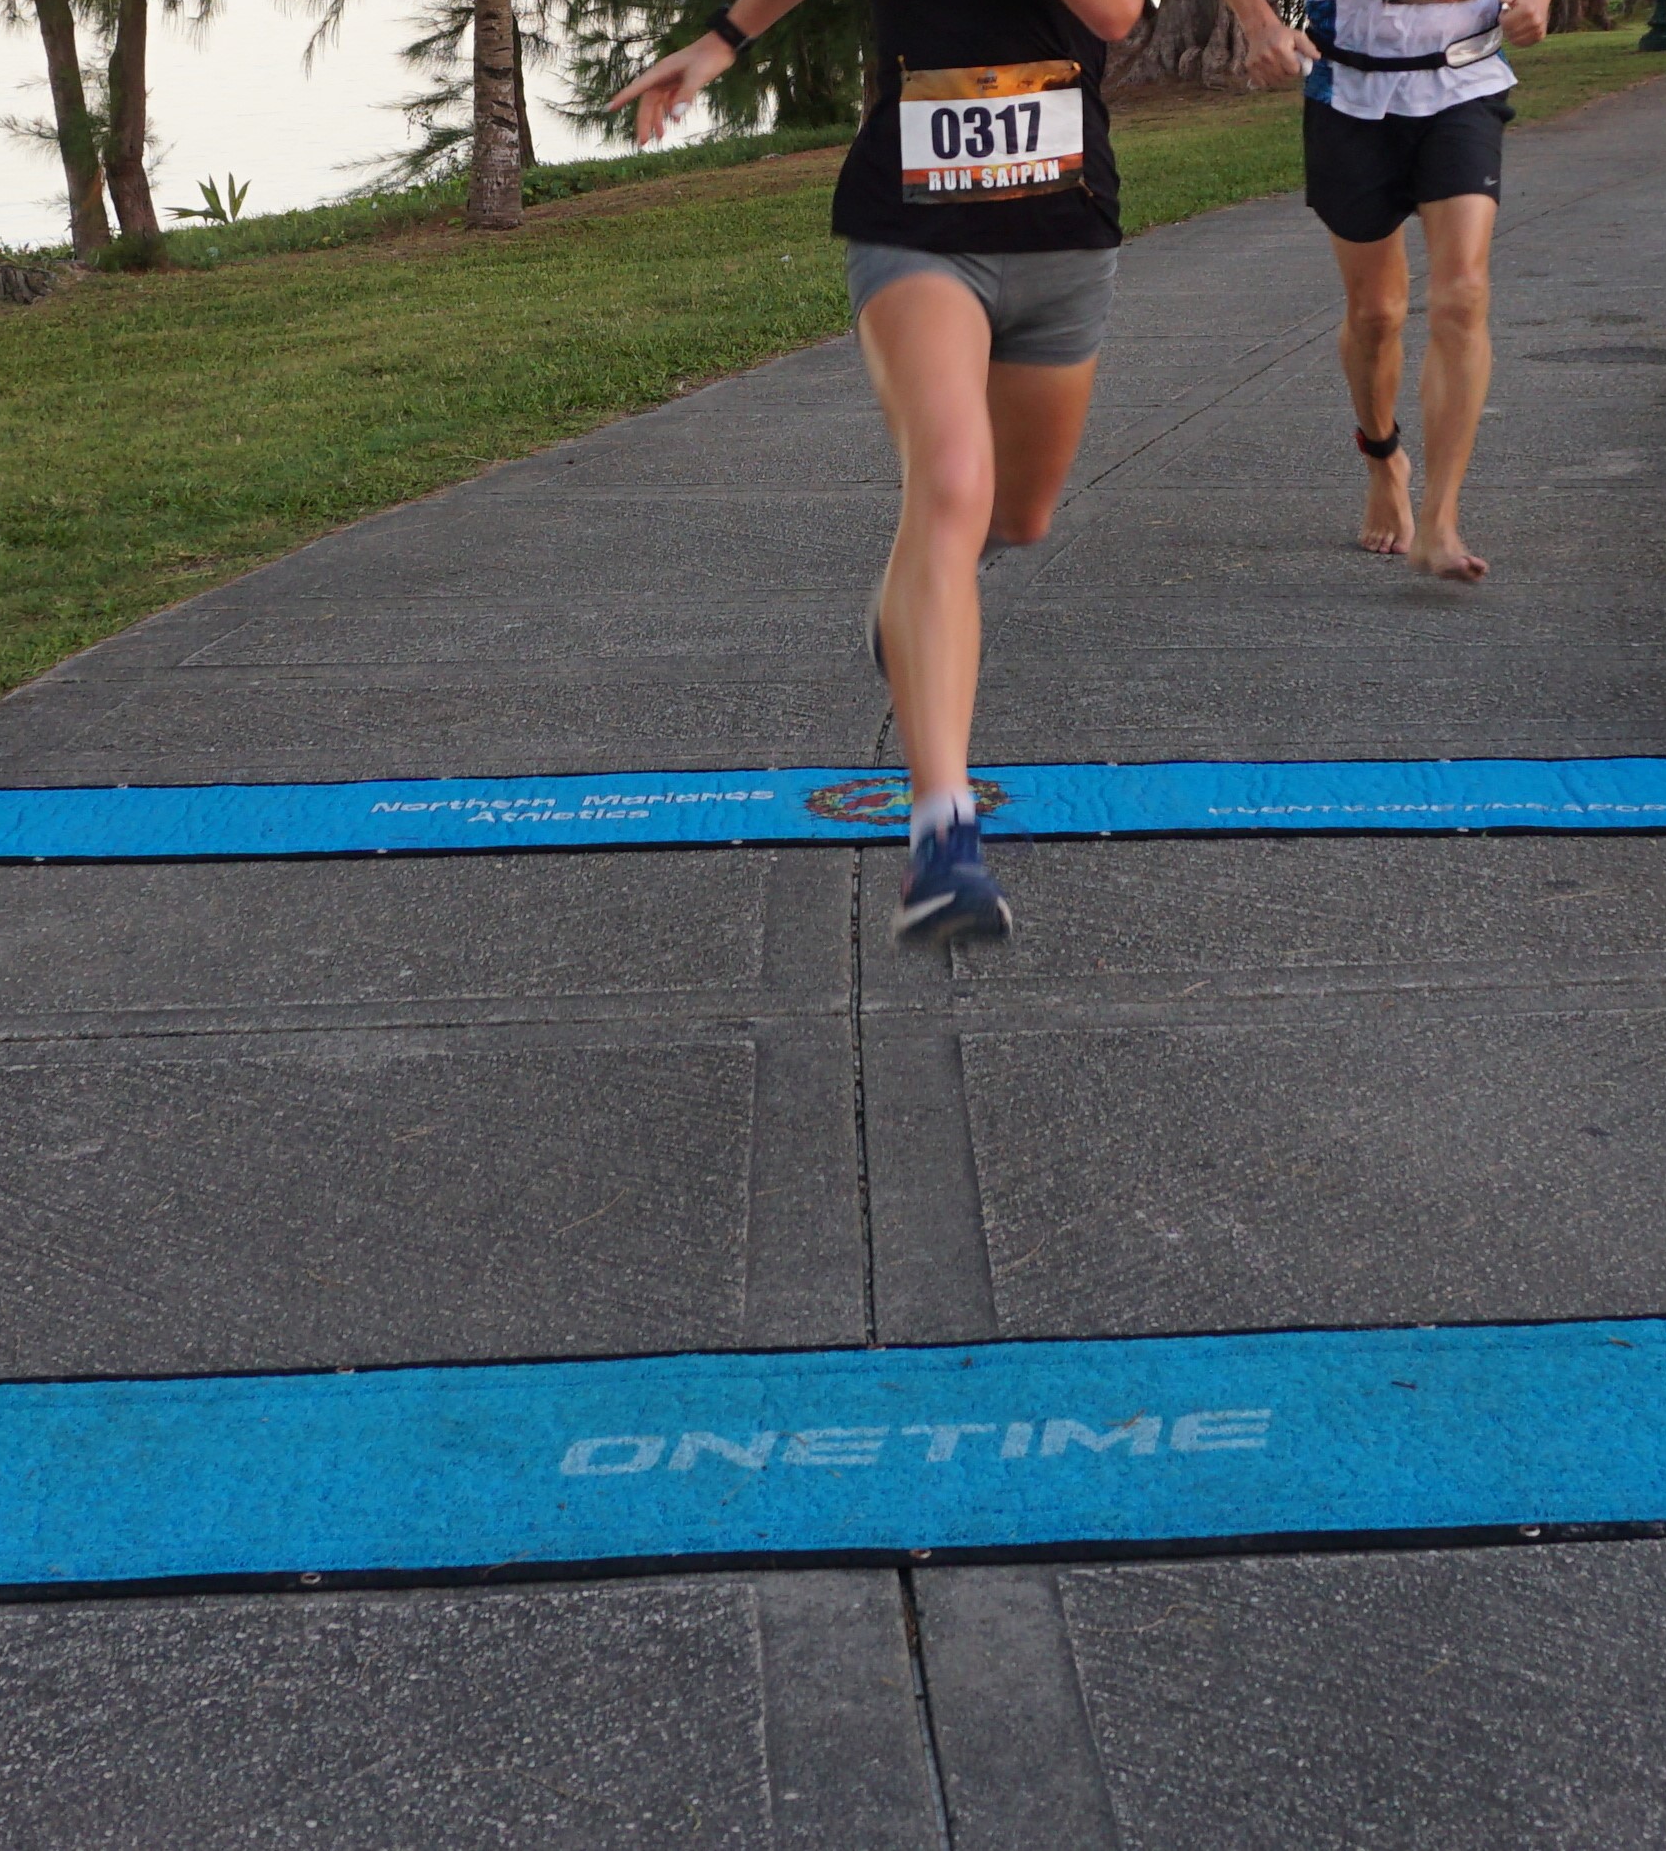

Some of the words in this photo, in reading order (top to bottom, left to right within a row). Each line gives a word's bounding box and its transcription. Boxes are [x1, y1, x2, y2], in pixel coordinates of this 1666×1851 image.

[930, 100, 1042, 160] 0317
[928, 168, 973, 192] RUN
[981, 159, 1061, 189] SAIPAN
[369, 797, 556, 814] Northern
[580, 789, 776, 807] Marianas
[467, 808, 651, 823] Athletics
[558, 1408, 1273, 1477] ONETIME
